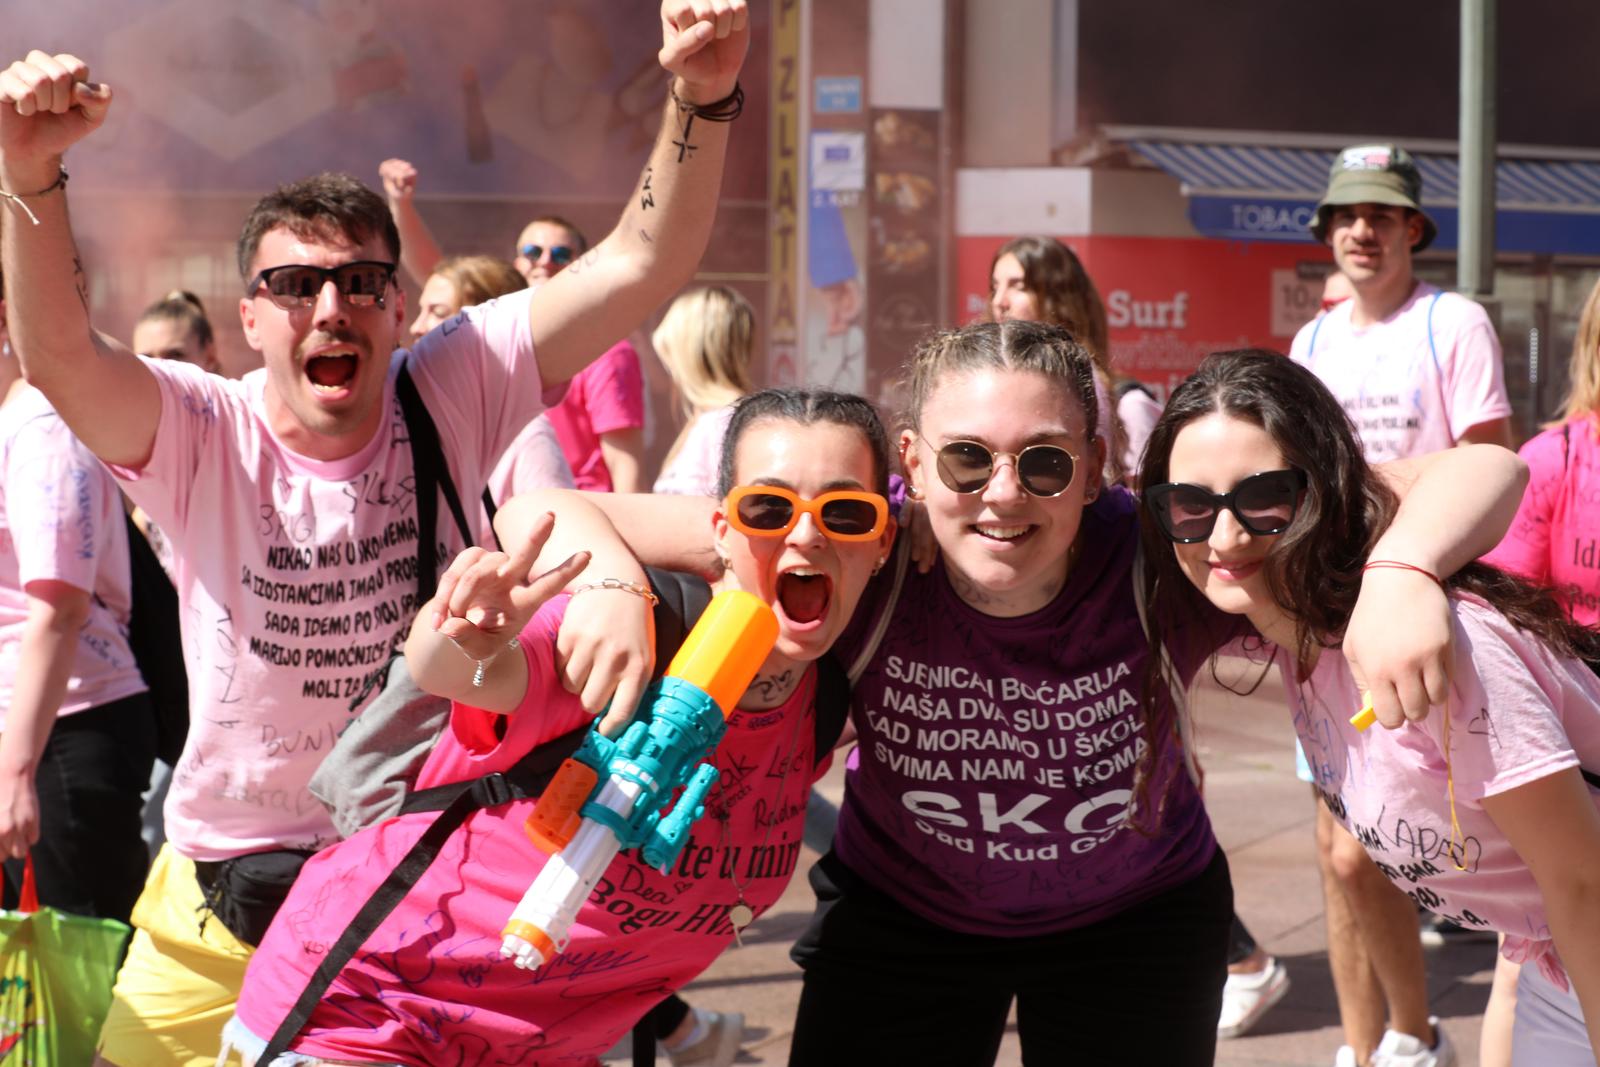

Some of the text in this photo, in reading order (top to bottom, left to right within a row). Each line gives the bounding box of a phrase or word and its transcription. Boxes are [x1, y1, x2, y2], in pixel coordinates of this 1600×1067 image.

[1107, 289, 1189, 329] Surf
[317, 542, 342, 569] NAS
[346, 541, 356, 566] U
[264, 611, 300, 637] SADA
[303, 614, 351, 638] IDEMO
[354, 611, 372, 634] PO
[249, 636, 301, 668] MARIJO
[303, 679, 340, 699] MOLI
[882, 686, 952, 721] NAŠA
[1013, 708, 1050, 732] SU
[1056, 688, 1138, 731] DOMA
[916, 728, 1041, 759] MORAMO
[1048, 738, 1067, 760] U
[1075, 714, 1146, 757] ŠKOL
[874, 736, 1148, 788] SVIMA NAM JE KOMA
[901, 789, 1139, 834] SKG
[986, 841, 1059, 862] Kud
